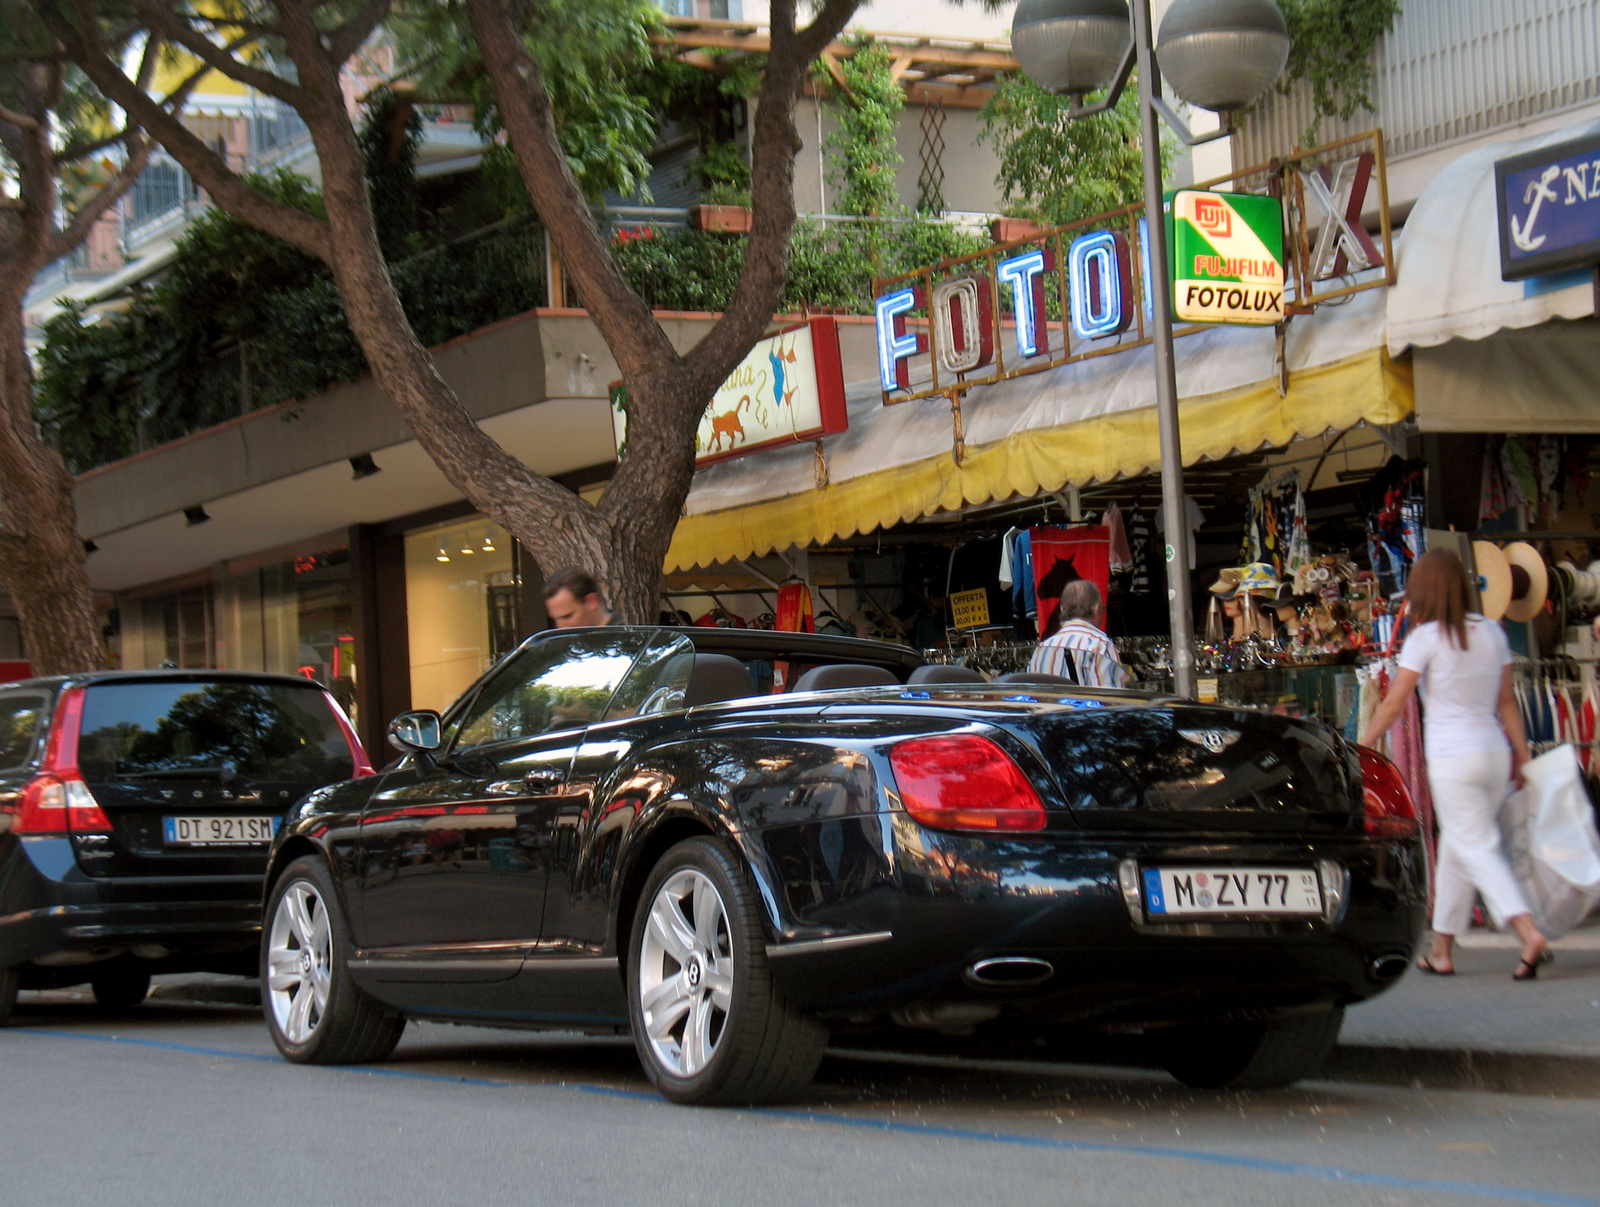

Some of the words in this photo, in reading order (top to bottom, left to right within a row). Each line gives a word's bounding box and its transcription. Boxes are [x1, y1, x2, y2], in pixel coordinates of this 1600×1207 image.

[1194, 255, 1275, 278] FUJIFILM
[1186, 285, 1282, 312] FOTOLUX
[953, 592, 984, 605] OFFERTA
[178, 818, 201, 839] DT
[210, 818, 272, 839] 921SM
[1152, 895, 1161, 906] D
[1173, 874, 1195, 907] M
[1213, 874, 1249, 907] ZY
[1258, 874, 1290, 907] 77
